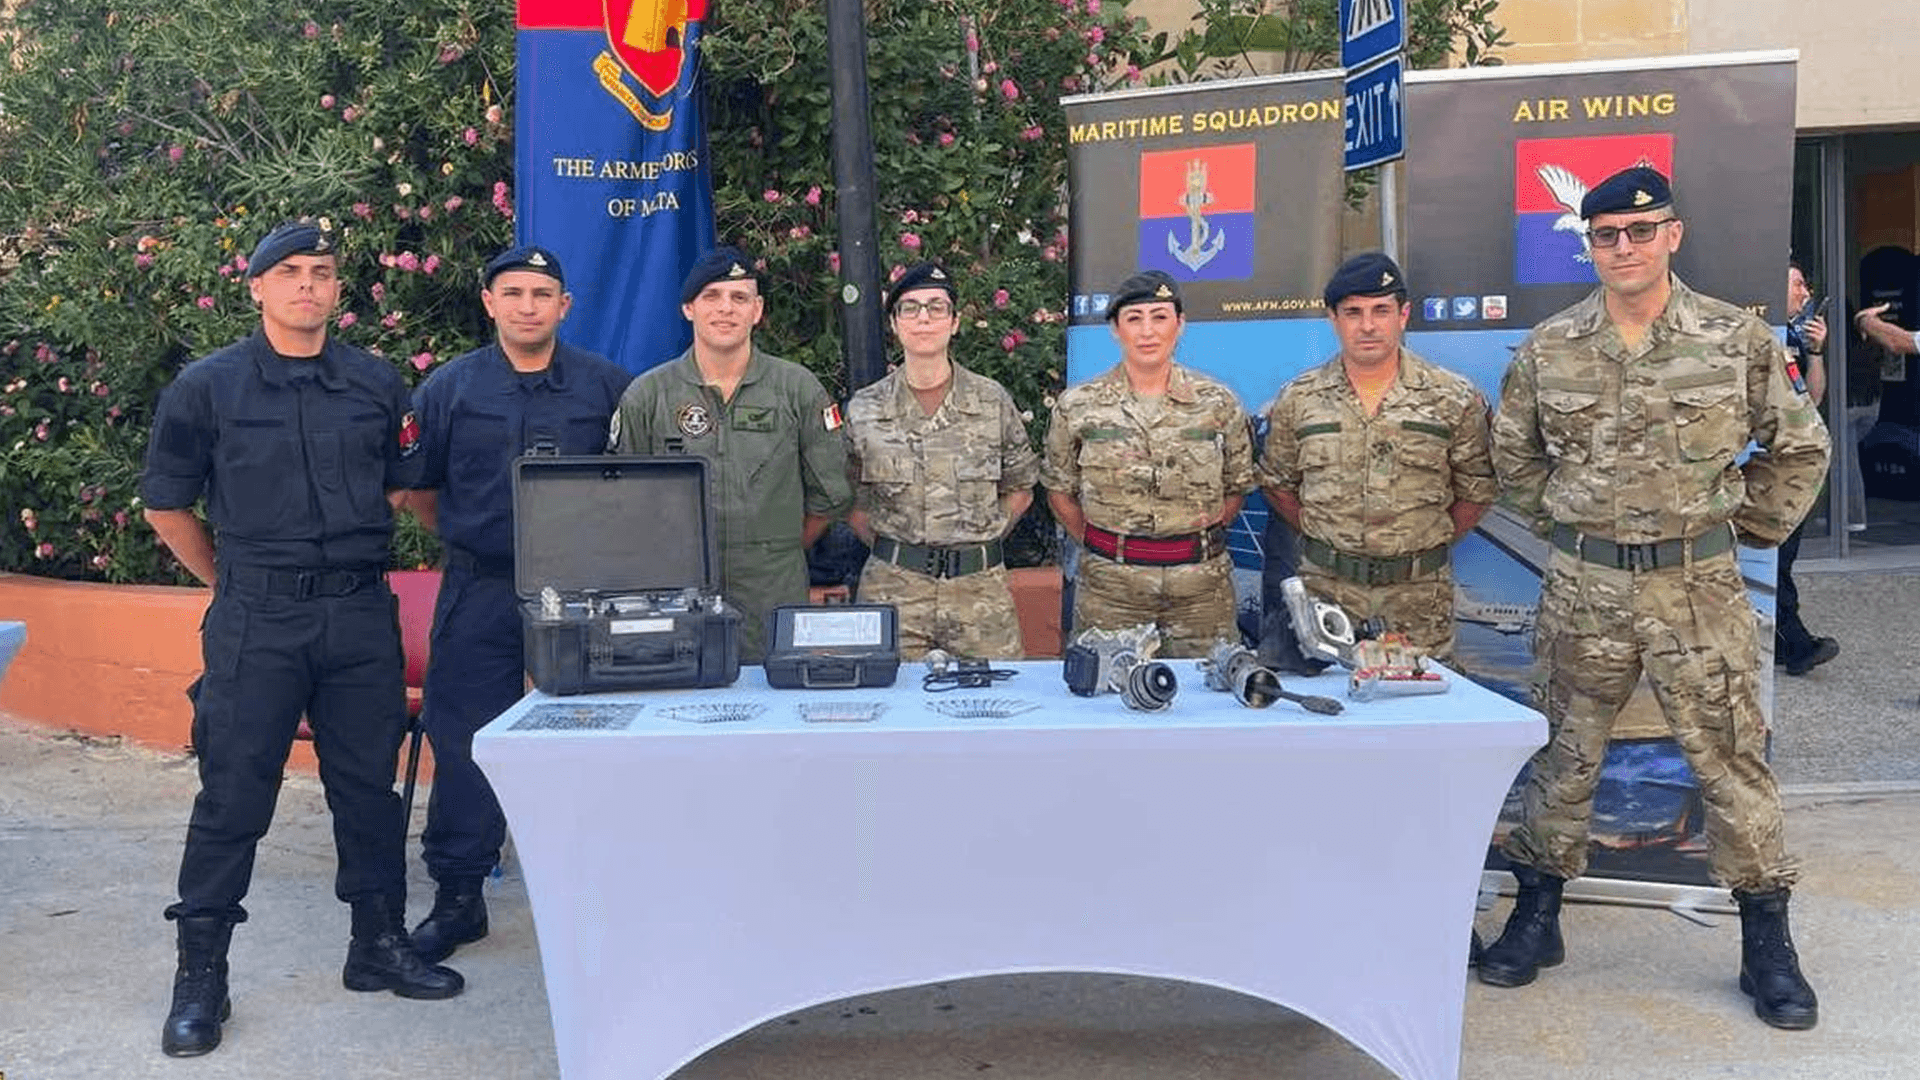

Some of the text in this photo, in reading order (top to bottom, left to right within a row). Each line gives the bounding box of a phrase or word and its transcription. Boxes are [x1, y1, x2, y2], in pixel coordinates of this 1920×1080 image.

[1069, 99, 1342, 144] MARITIME SQUADRON
[1345, 82, 1384, 151] EXIT
[1514, 93, 1677, 123] AIR WING
[553, 158, 595, 177] THE
[599, 160, 660, 180] ARME
[608, 191, 680, 217] OF MLTA
